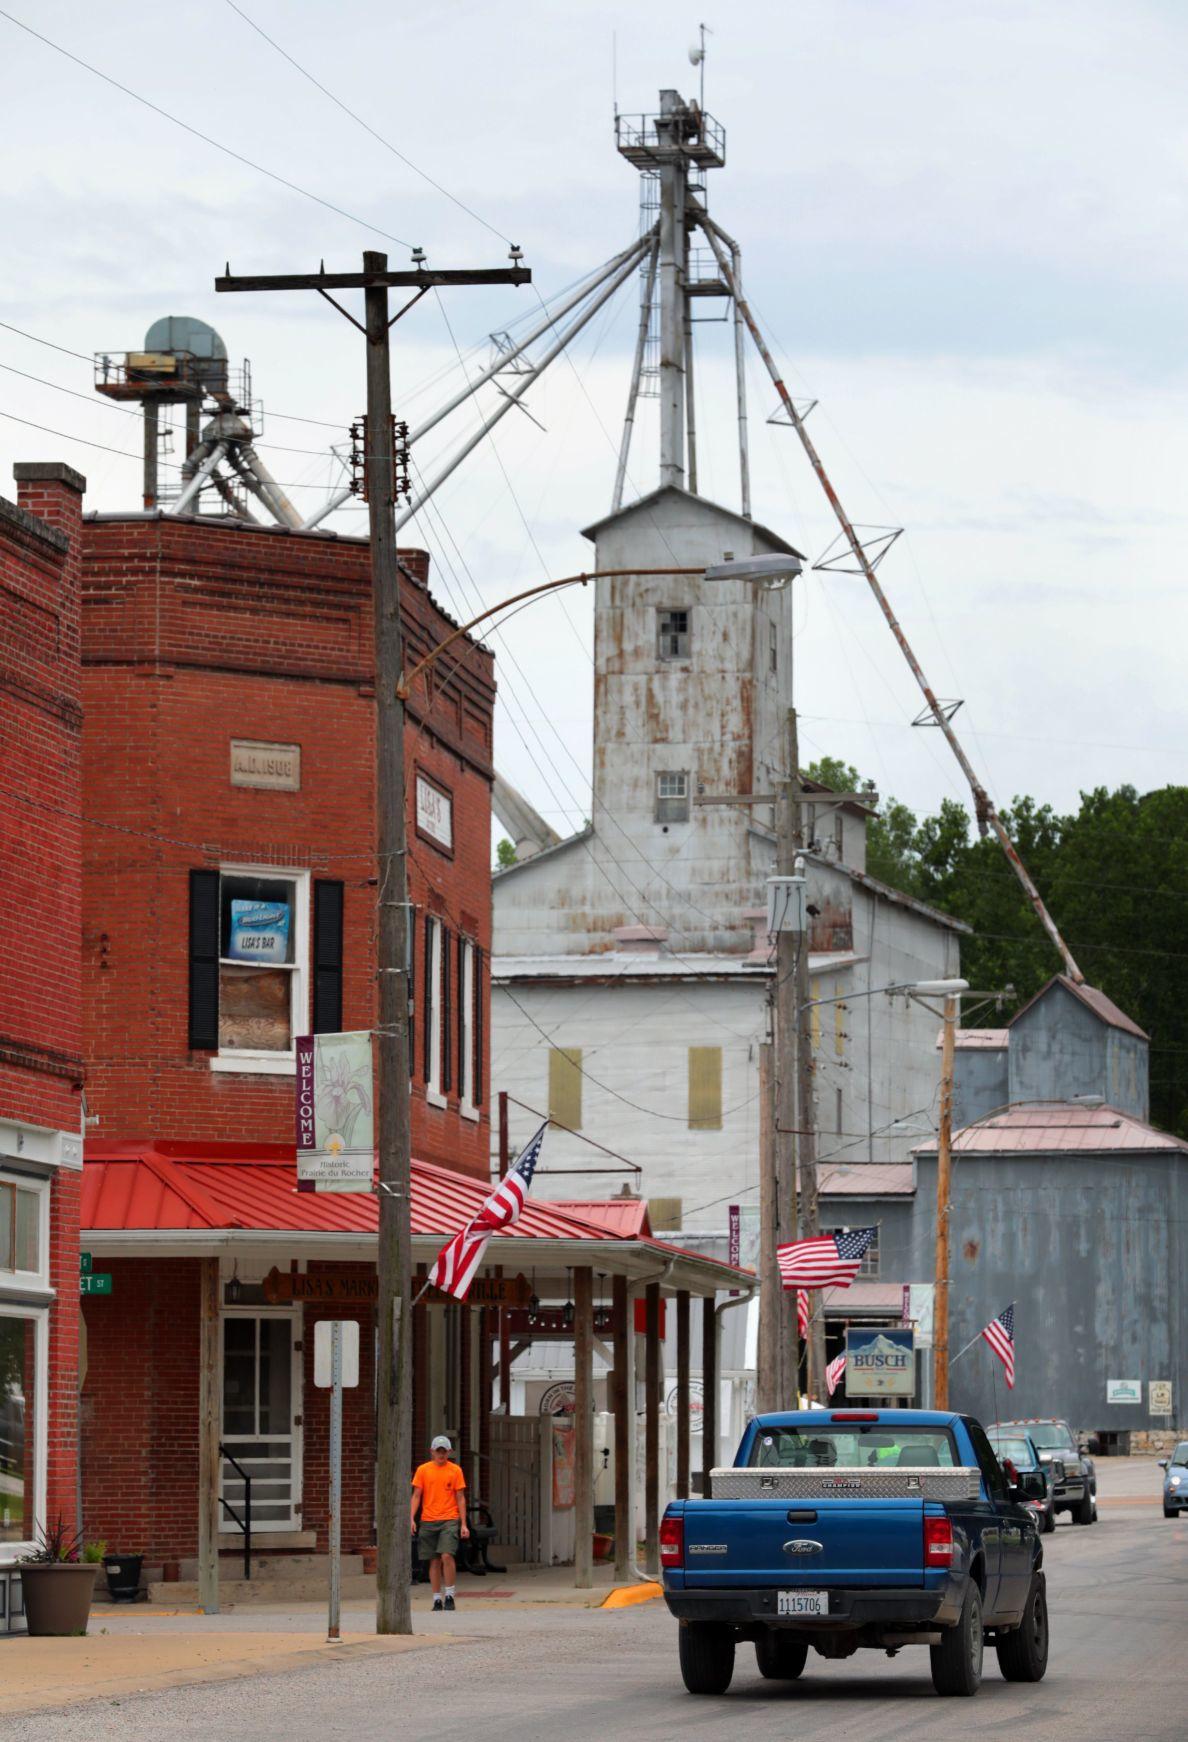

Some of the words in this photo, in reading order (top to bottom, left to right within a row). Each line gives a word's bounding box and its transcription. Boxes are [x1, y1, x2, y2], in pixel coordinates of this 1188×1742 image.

[261, 936, 276, 949] BAR
[300, 1051, 313, 1146] WELCOME
[320, 1160, 350, 1169] Historic
[301, 1168, 326, 1177] Prairie
[327, 1168, 339, 1177] du
[341, 1168, 370, 1177] Rocher
[96, 1279, 105, 1288] ST
[854, 1354, 906, 1368] BUSCH
[791, 1542, 814, 1553] Ford
[779, 1597, 821, 1612] 1115706
